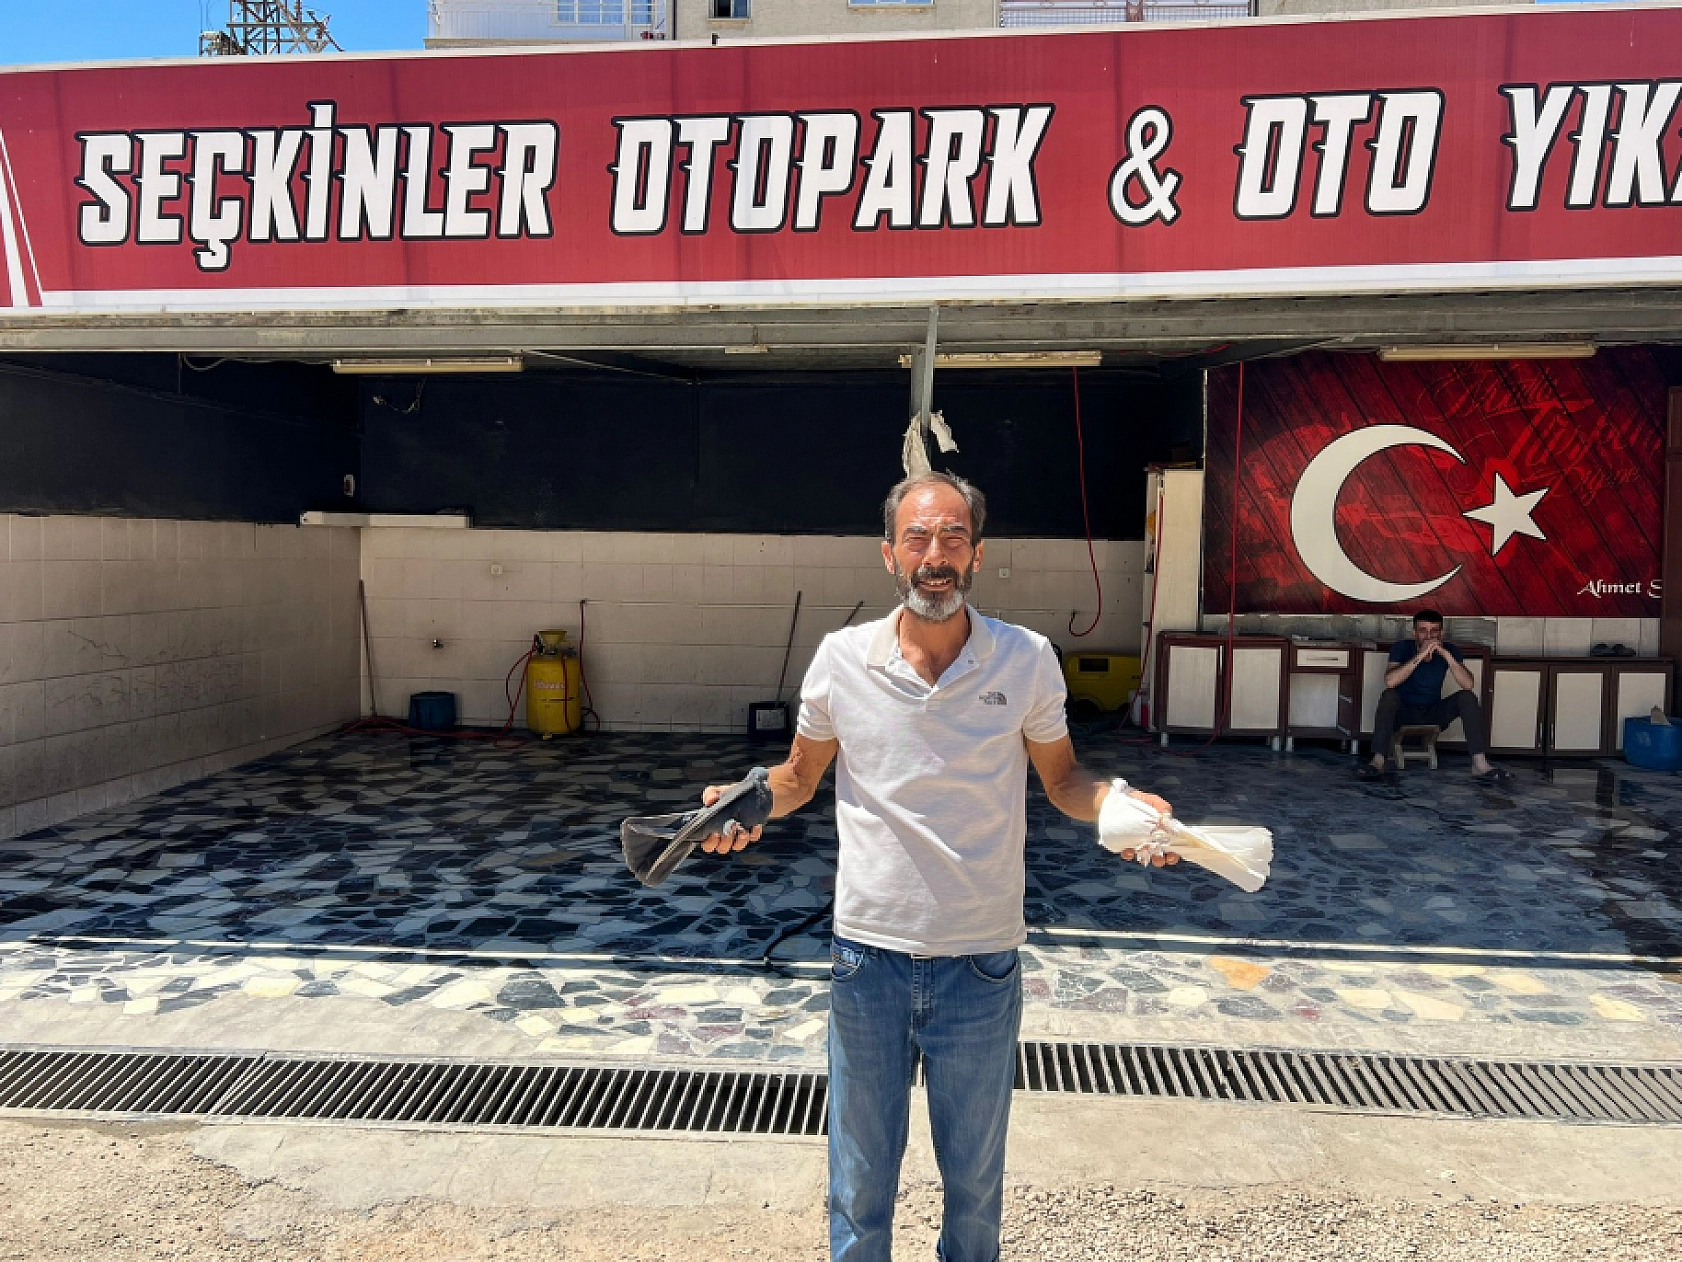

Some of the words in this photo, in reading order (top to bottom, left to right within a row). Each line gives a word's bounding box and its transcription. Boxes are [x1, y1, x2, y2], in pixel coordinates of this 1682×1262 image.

[75, 101, 560, 271] SEÇKİNLER
[610, 104, 1055, 235] OTOPARK
[1108, 105, 1182, 226] &
[1234, 88, 1443, 218] OTO
[1498, 78, 1682, 211] YIK
[1576, 579, 1642, 598] Ahmet
